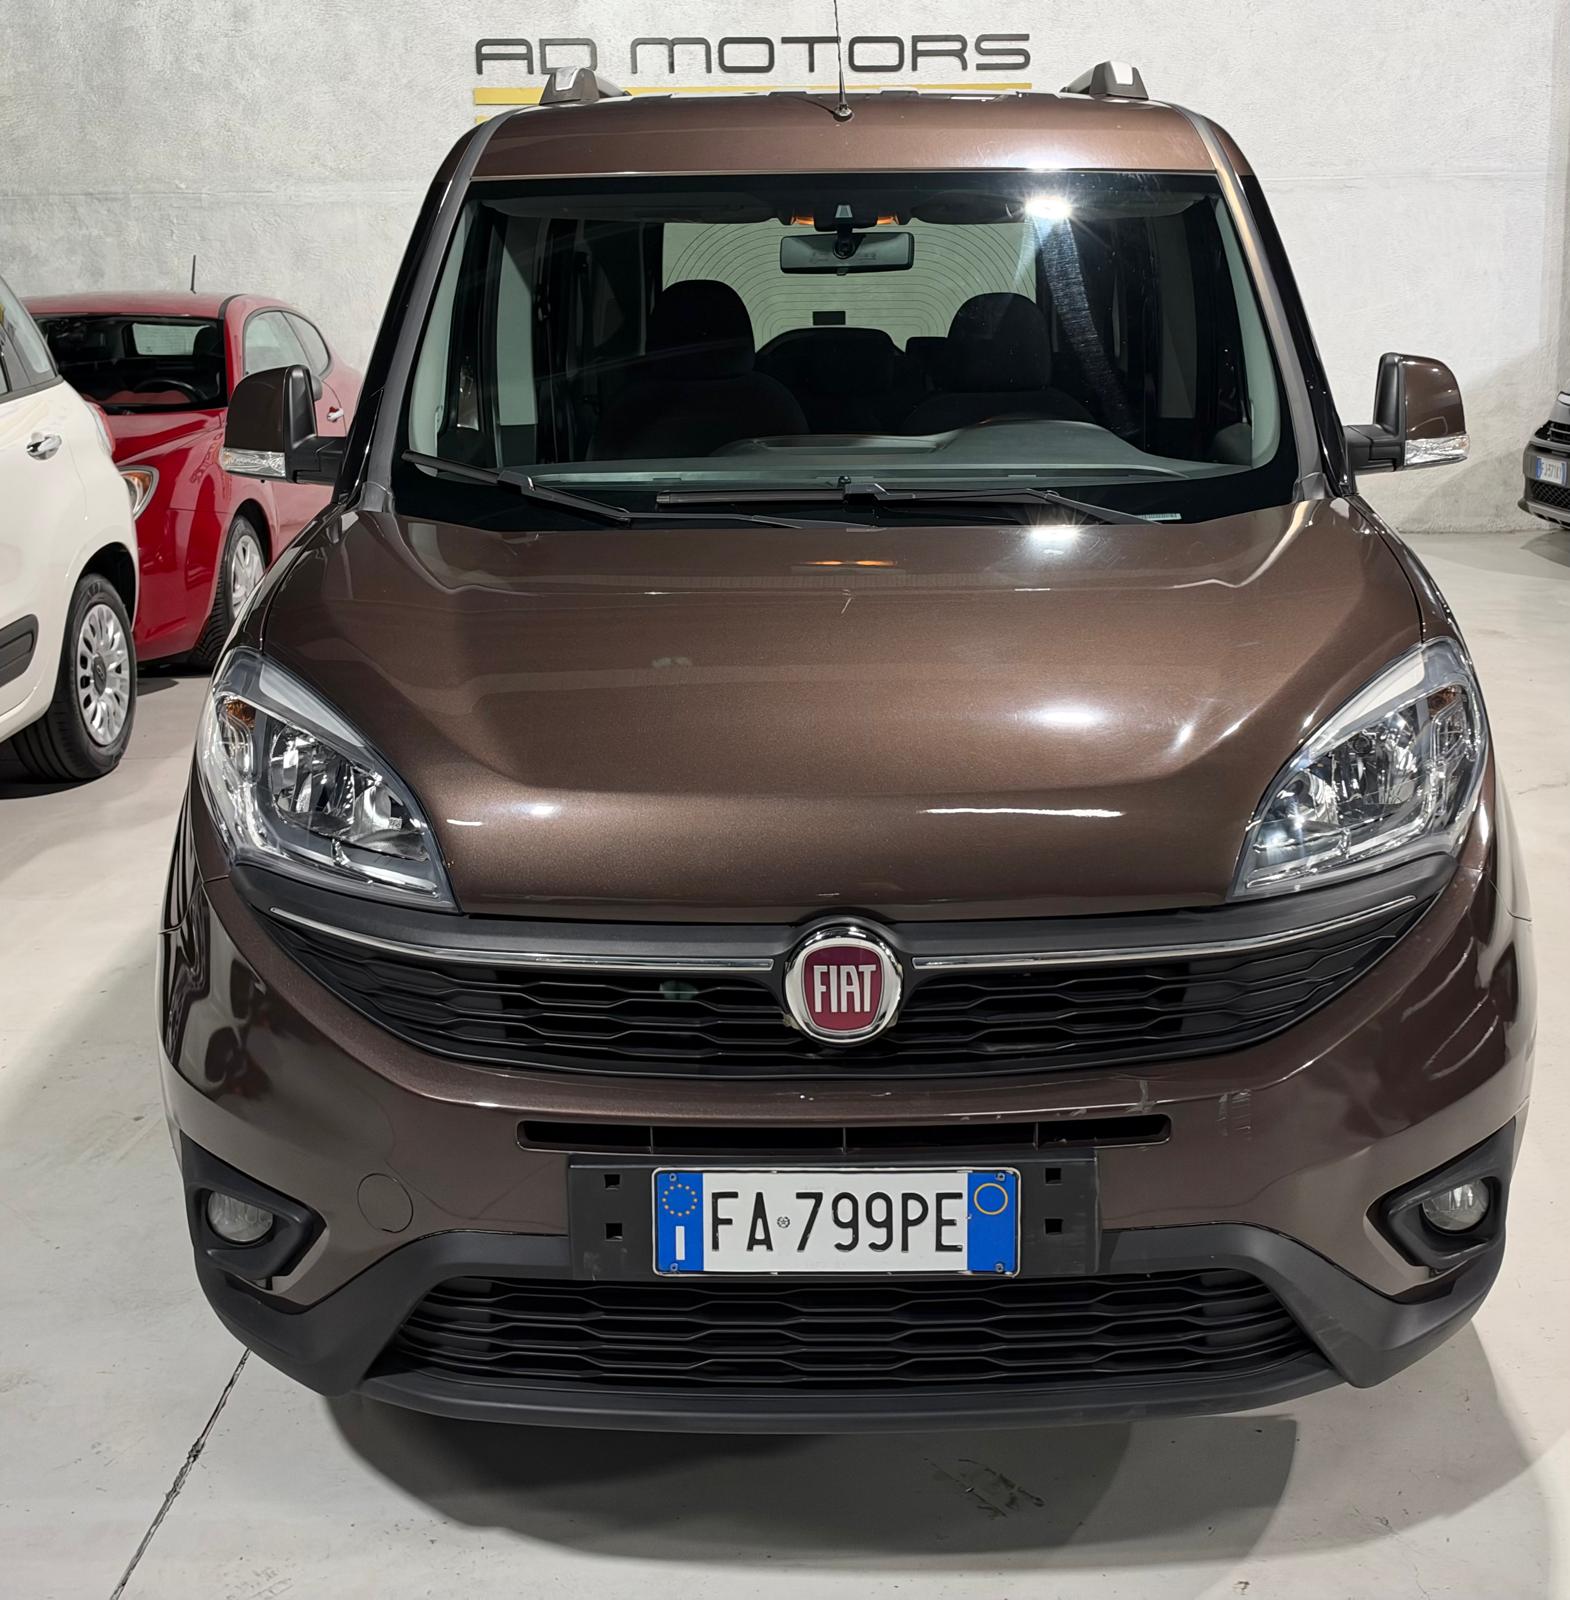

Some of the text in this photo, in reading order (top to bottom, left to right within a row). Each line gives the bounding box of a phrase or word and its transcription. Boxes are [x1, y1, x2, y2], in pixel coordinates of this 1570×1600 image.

[475, 33, 1031, 75] AD MOTORS
[813, 964, 877, 1013] FIAT
